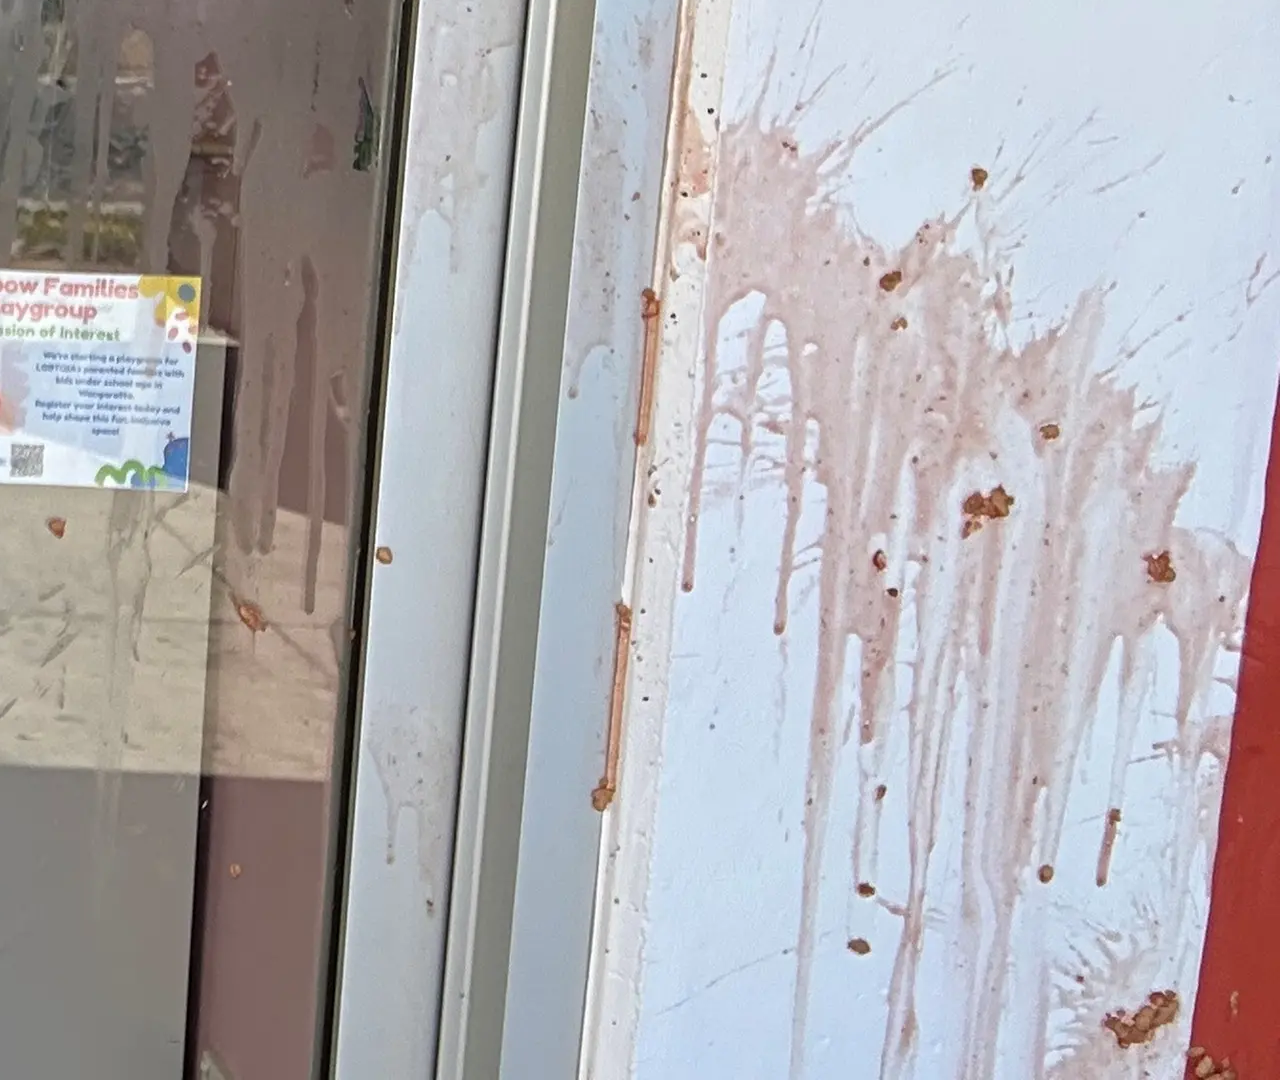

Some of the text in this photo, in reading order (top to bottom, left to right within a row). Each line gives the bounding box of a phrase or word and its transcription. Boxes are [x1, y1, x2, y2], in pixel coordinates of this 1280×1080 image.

[44, 277, 139, 299] Families
[40, 325, 55, 337] of
[60, 326, 120, 341] Interest
